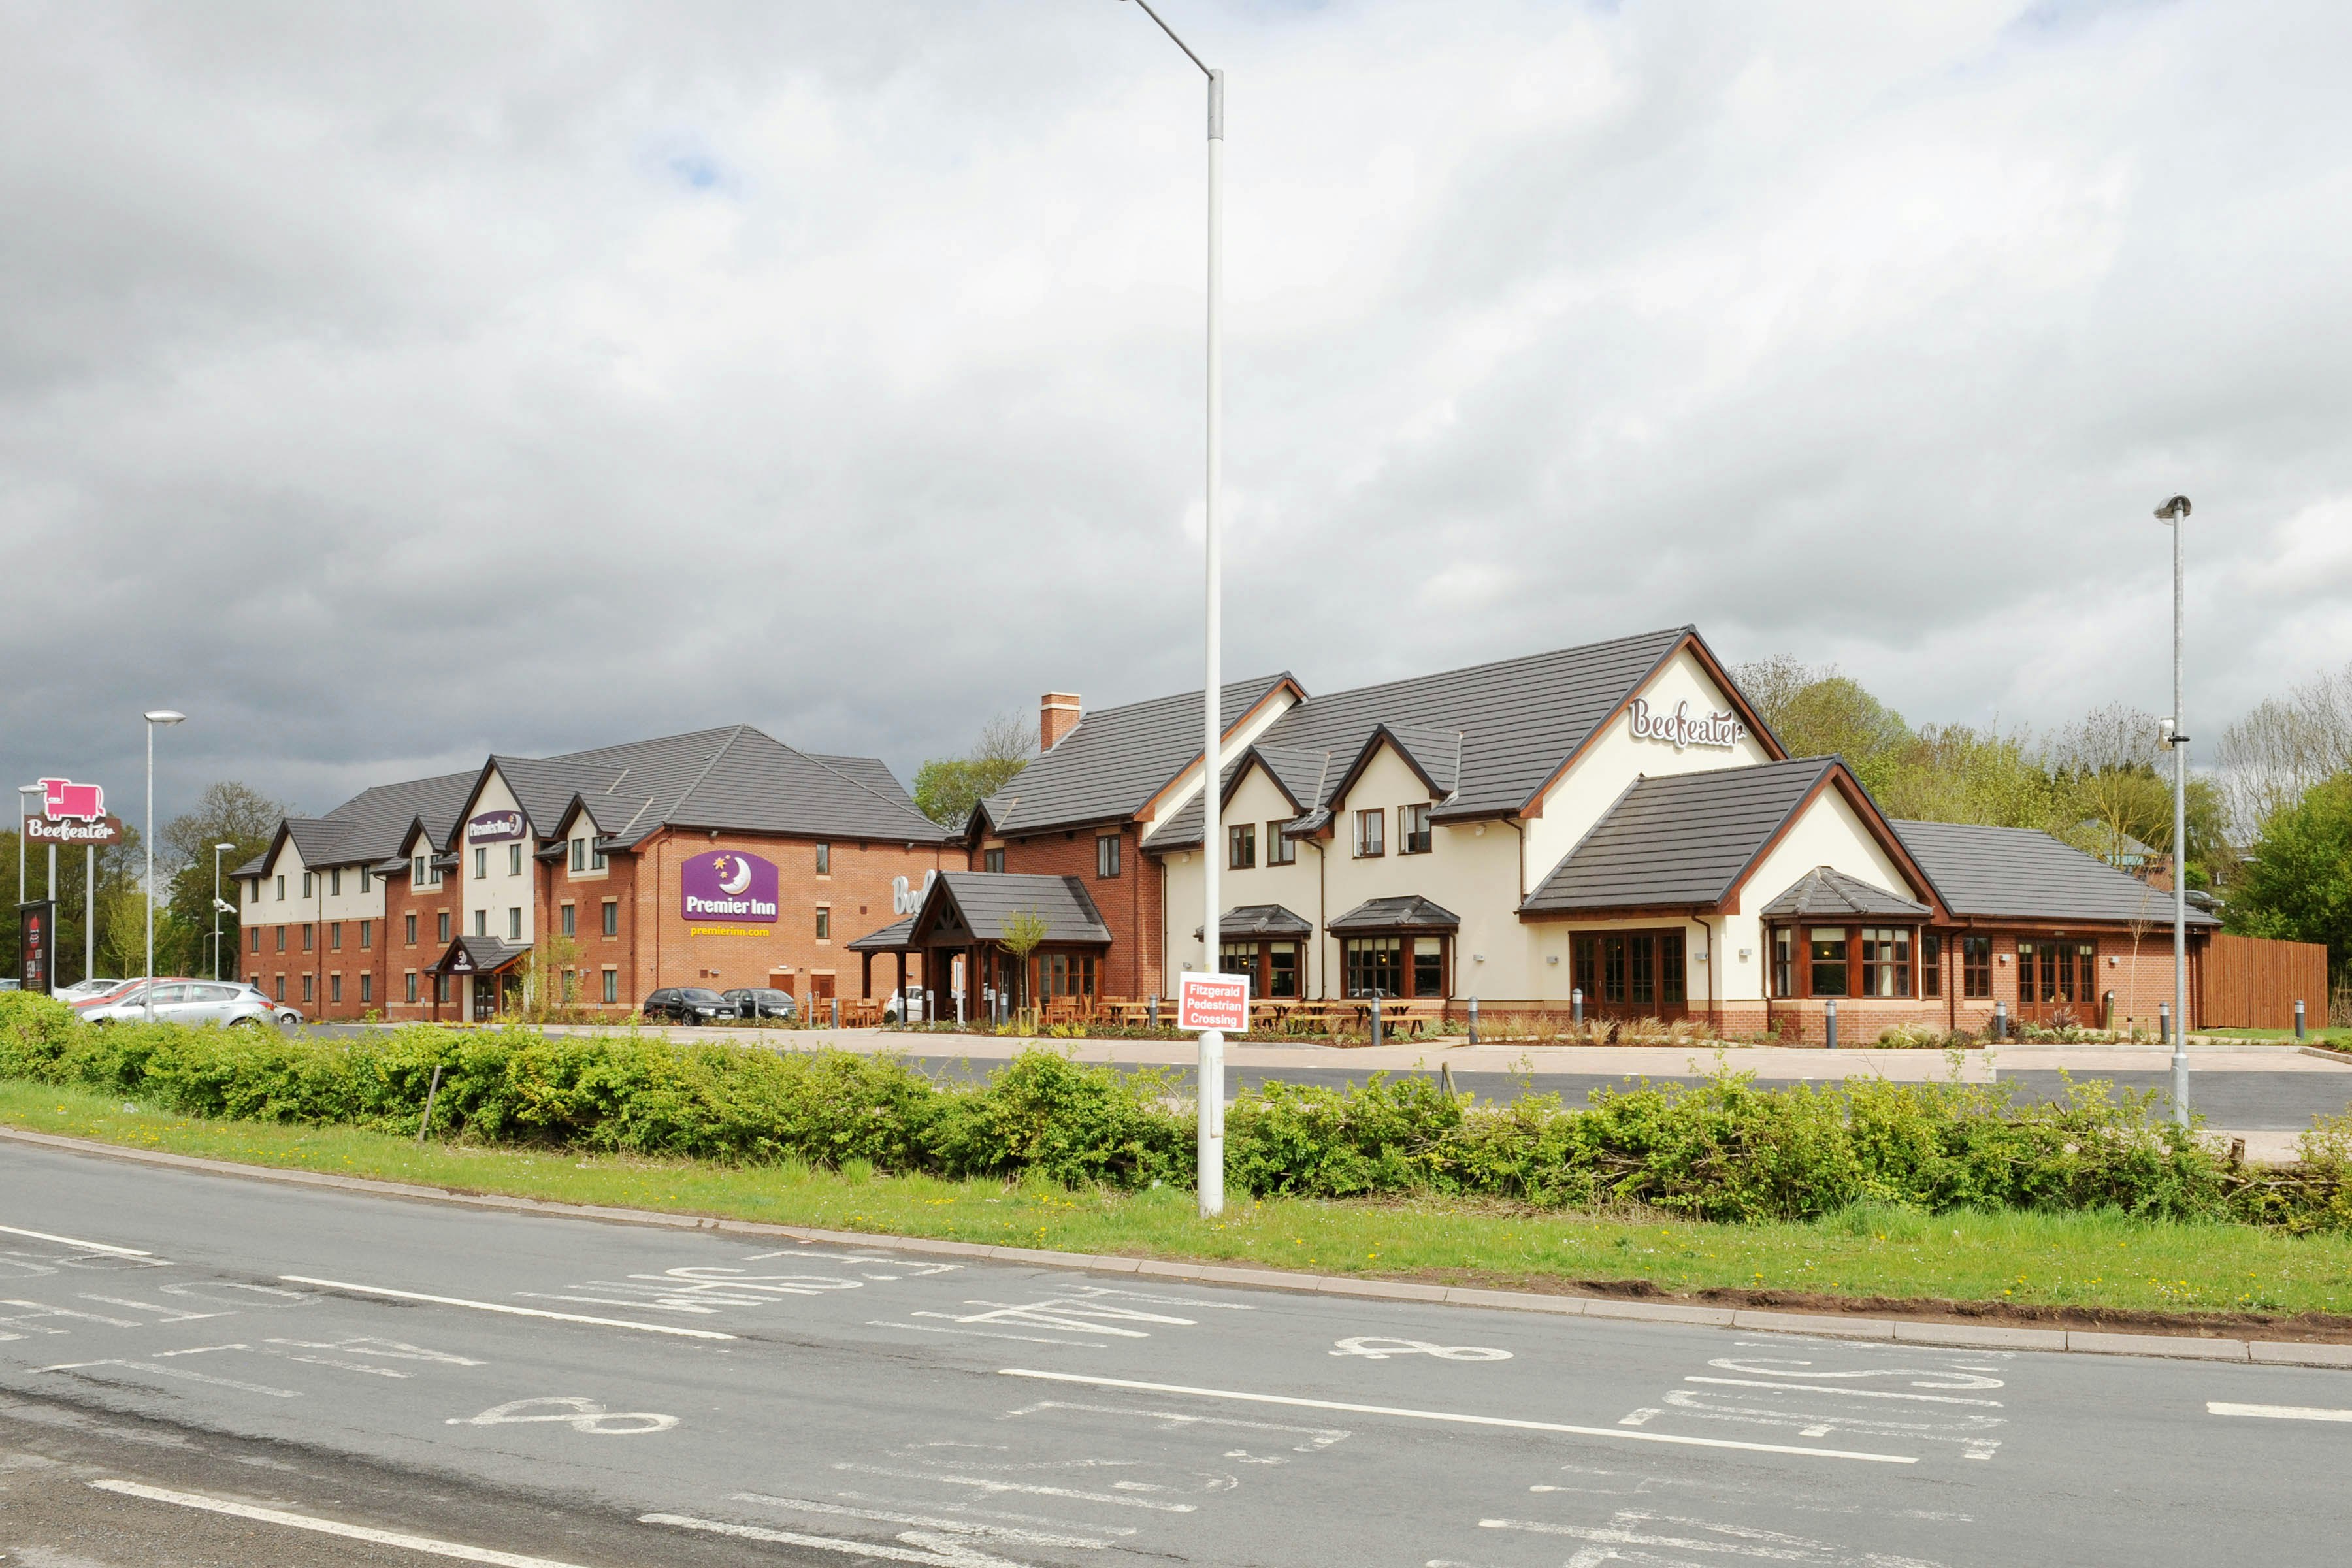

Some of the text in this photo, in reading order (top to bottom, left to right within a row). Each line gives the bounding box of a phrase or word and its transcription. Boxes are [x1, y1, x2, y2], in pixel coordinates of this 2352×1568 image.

[1631, 698, 1746, 745] Beefeater
[27, 819, 115, 841] Beefeater
[687, 896, 776, 915] Premier Inn
[691, 926, 769, 937] premierinn.com
[1190, 983, 1240, 998] Fitzgerald
[1187, 998, 1241, 1011] Pedestrian
[1190, 1013, 1237, 1028] Crossing
